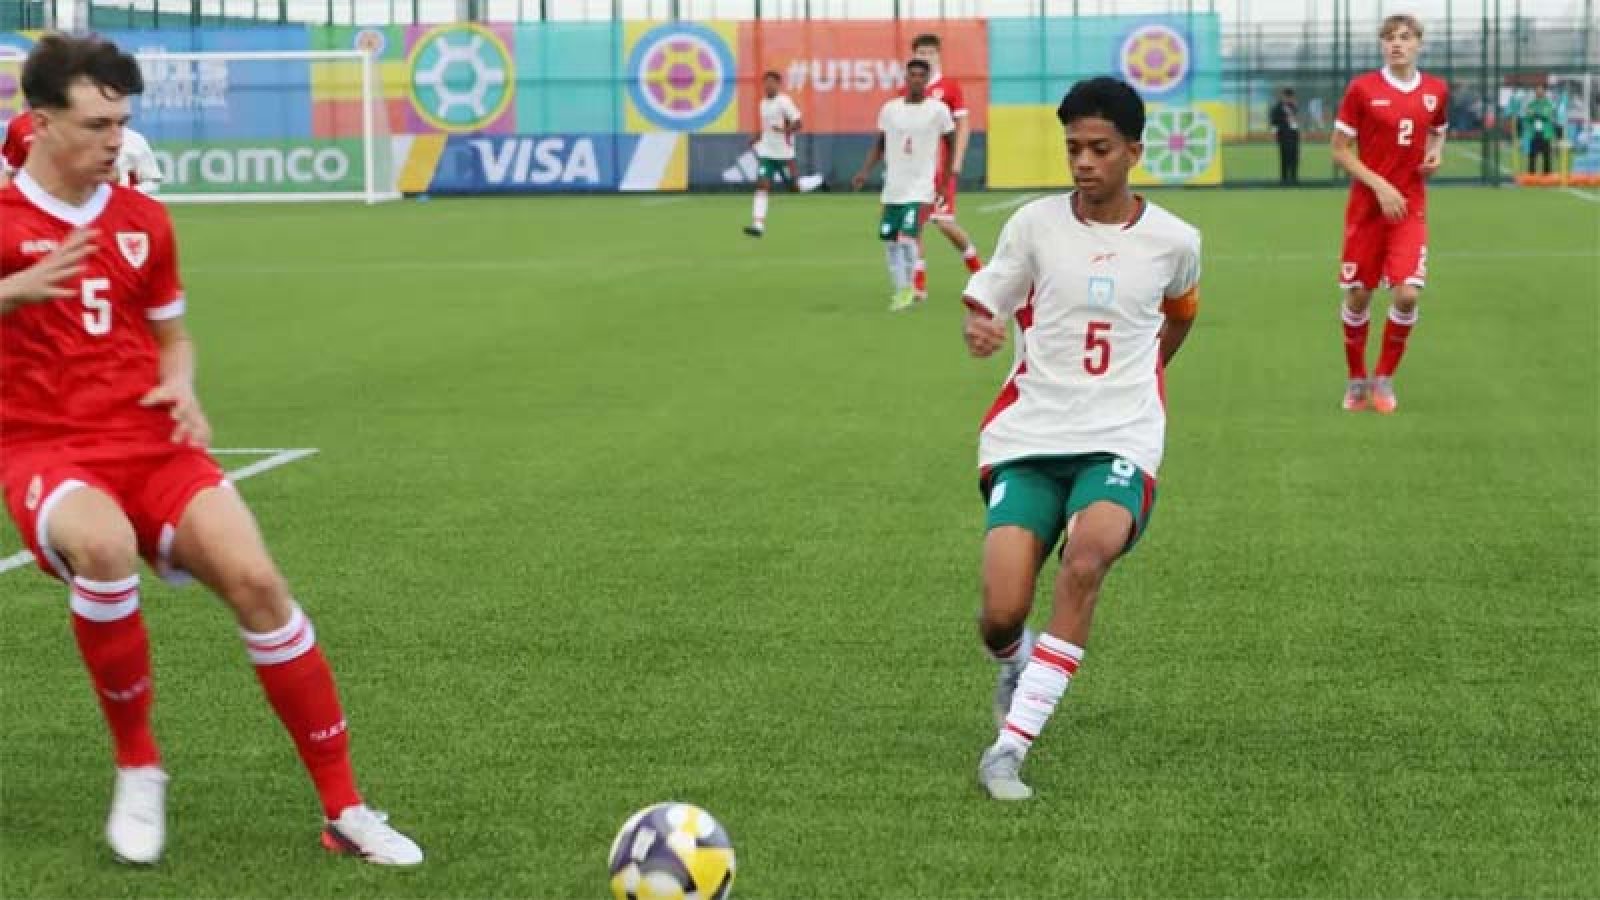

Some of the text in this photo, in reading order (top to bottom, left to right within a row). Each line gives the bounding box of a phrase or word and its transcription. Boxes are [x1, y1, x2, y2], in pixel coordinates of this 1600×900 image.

[1397, 118, 1414, 145] 2
[469, 139, 599, 184] VISA
[81, 278, 112, 336] 5
[1083, 321, 1112, 377] 5
